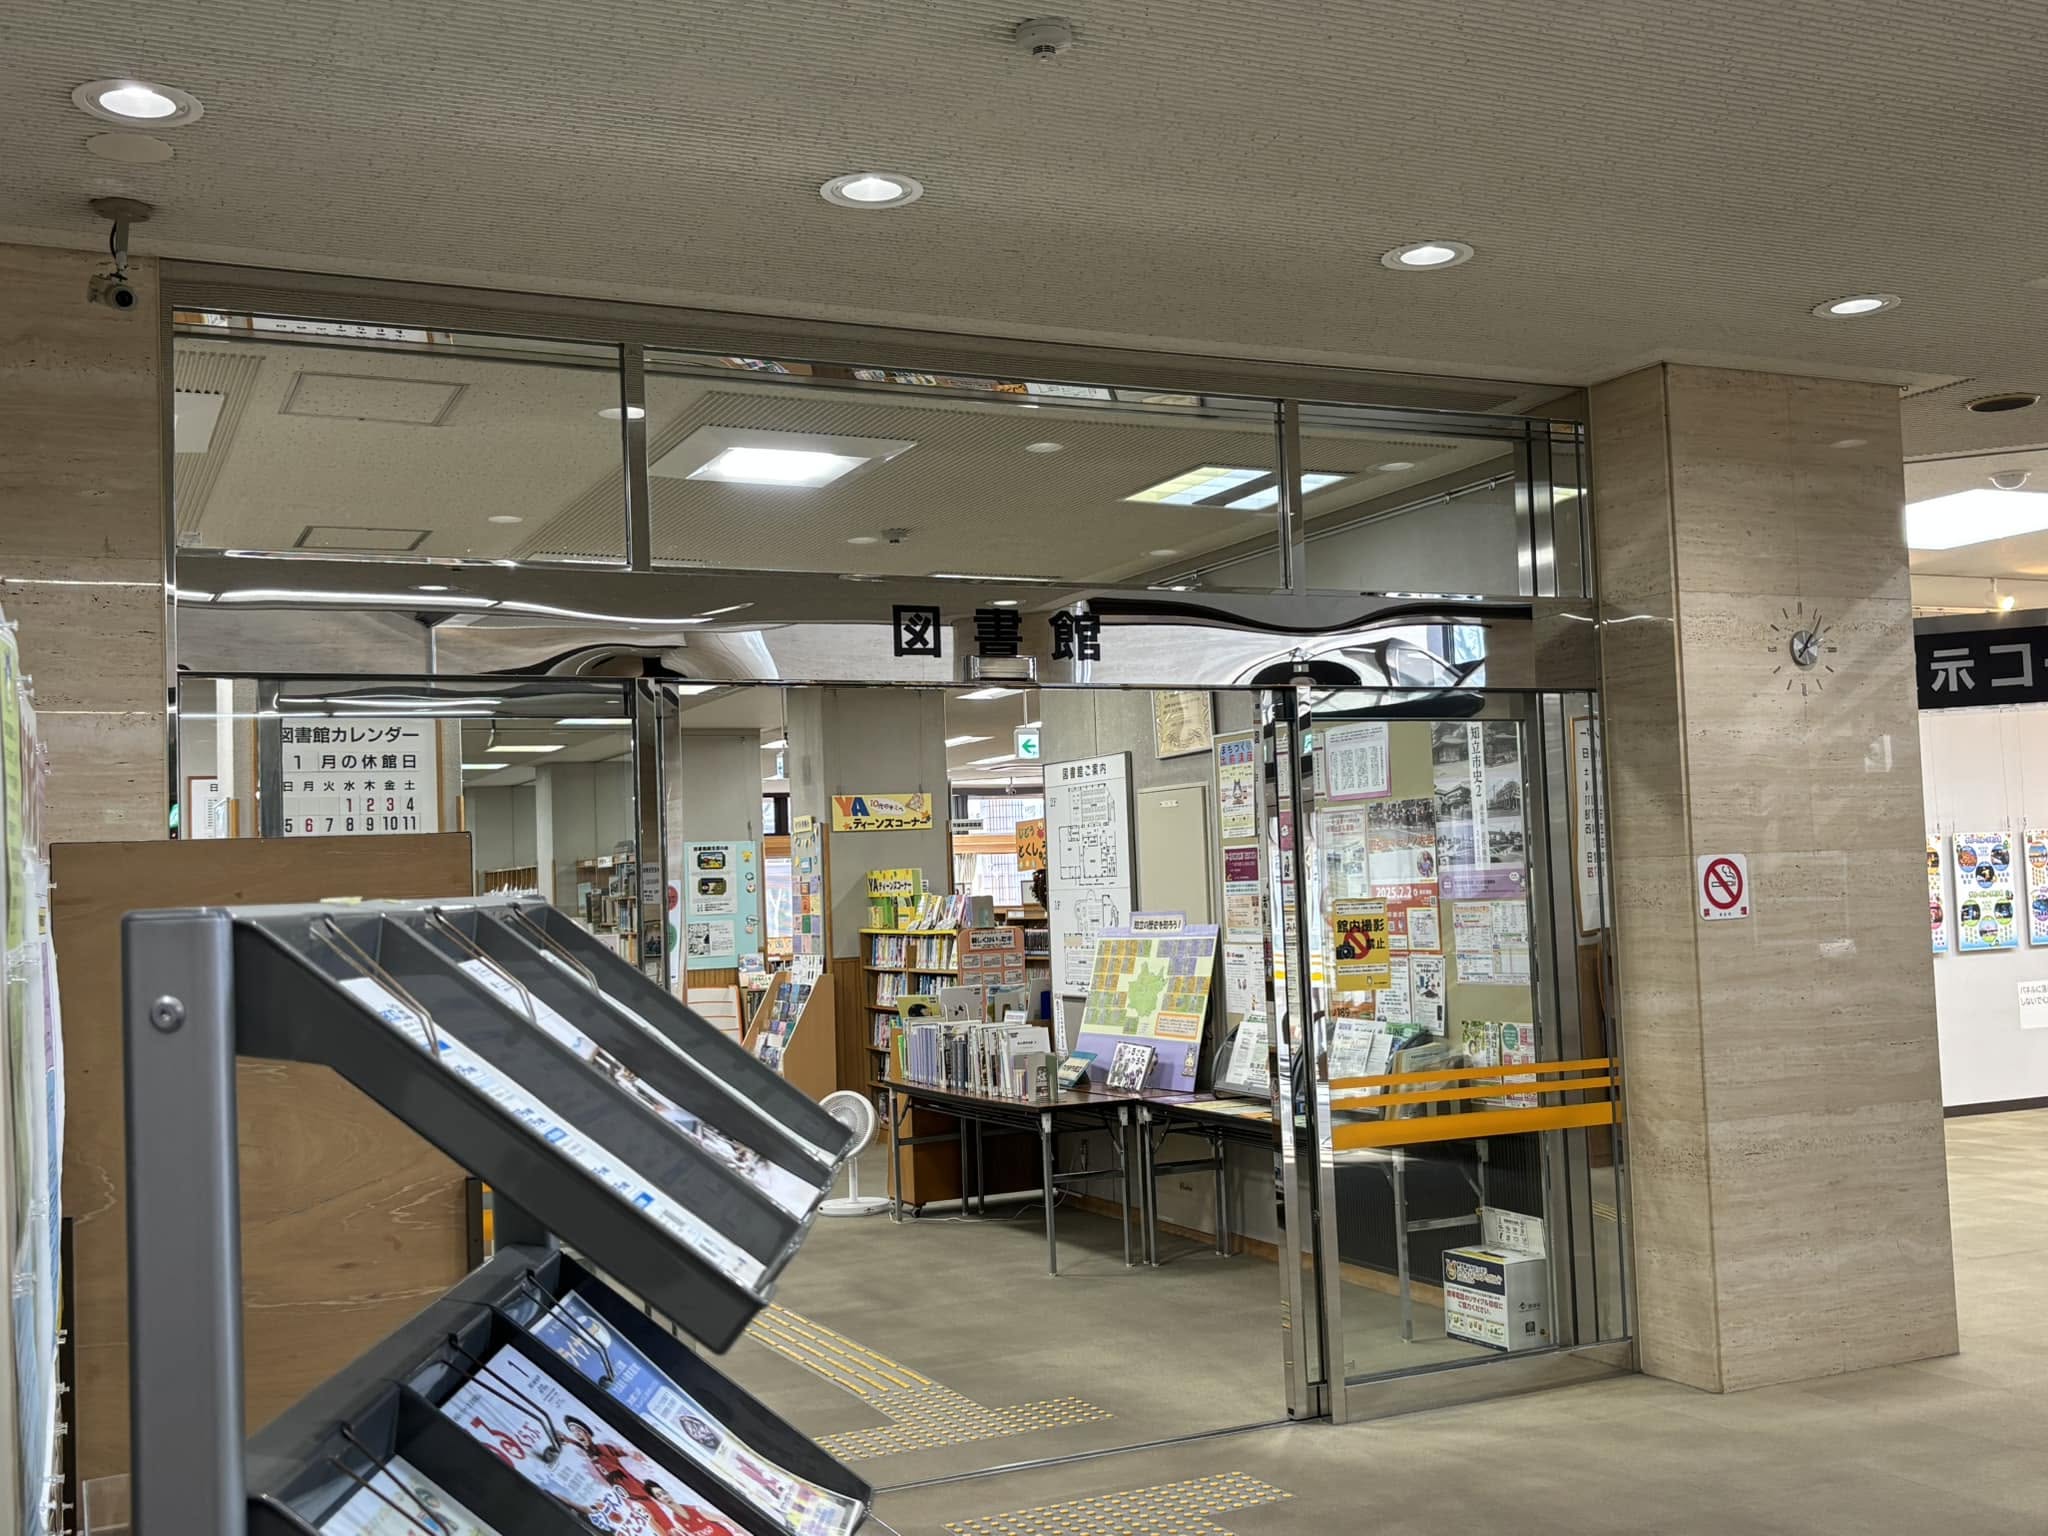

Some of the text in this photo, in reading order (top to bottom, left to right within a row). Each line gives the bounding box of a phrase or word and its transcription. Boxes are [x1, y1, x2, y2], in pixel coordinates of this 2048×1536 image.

[892, 605, 1101, 662] 図書館
[1930, 643, 2048, 692] 示コ
[281, 726, 420, 744] 図書館カレンダー
[284, 780, 416, 791] 日 月 火 水 木 金 土
[346, 797, 415, 812] 1 2 3 4
[835, 797, 870, 816] YA
[284, 816, 416, 833] 5 6 7 8 9 10 11
[852, 817, 931, 829] ティーンズコーナー
[1336, 918, 1385, 933] 館内撮影
